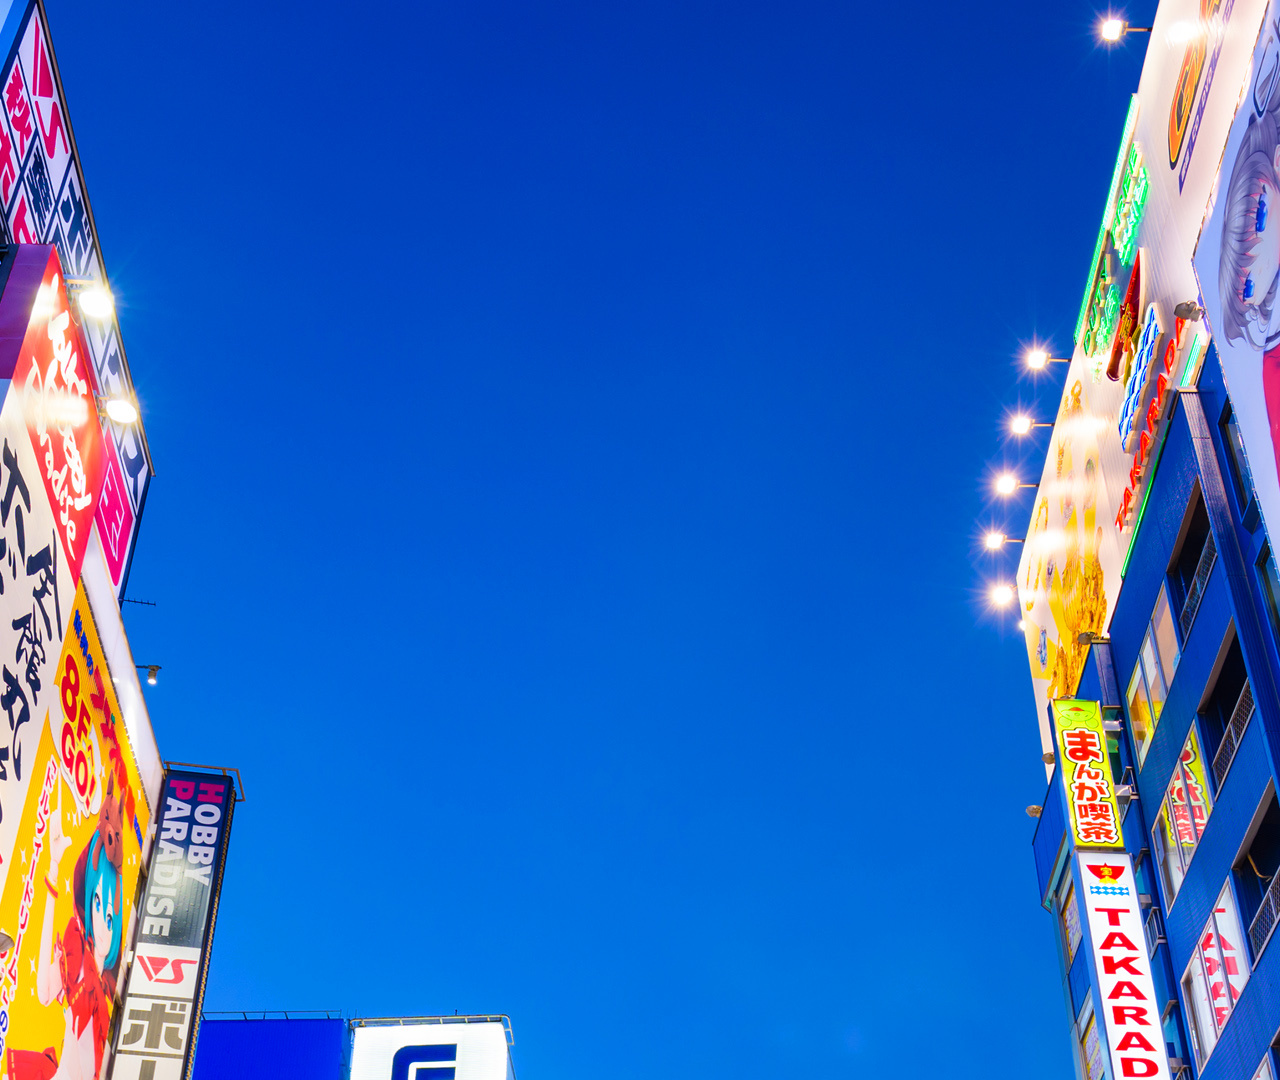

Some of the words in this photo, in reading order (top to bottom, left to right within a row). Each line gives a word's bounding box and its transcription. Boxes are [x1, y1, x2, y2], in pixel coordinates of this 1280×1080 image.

[185, 782, 227, 888] HOBBY
[1064, 728, 1118, 844] まんが喫茶
[143, 779, 195, 938] PARADISE
